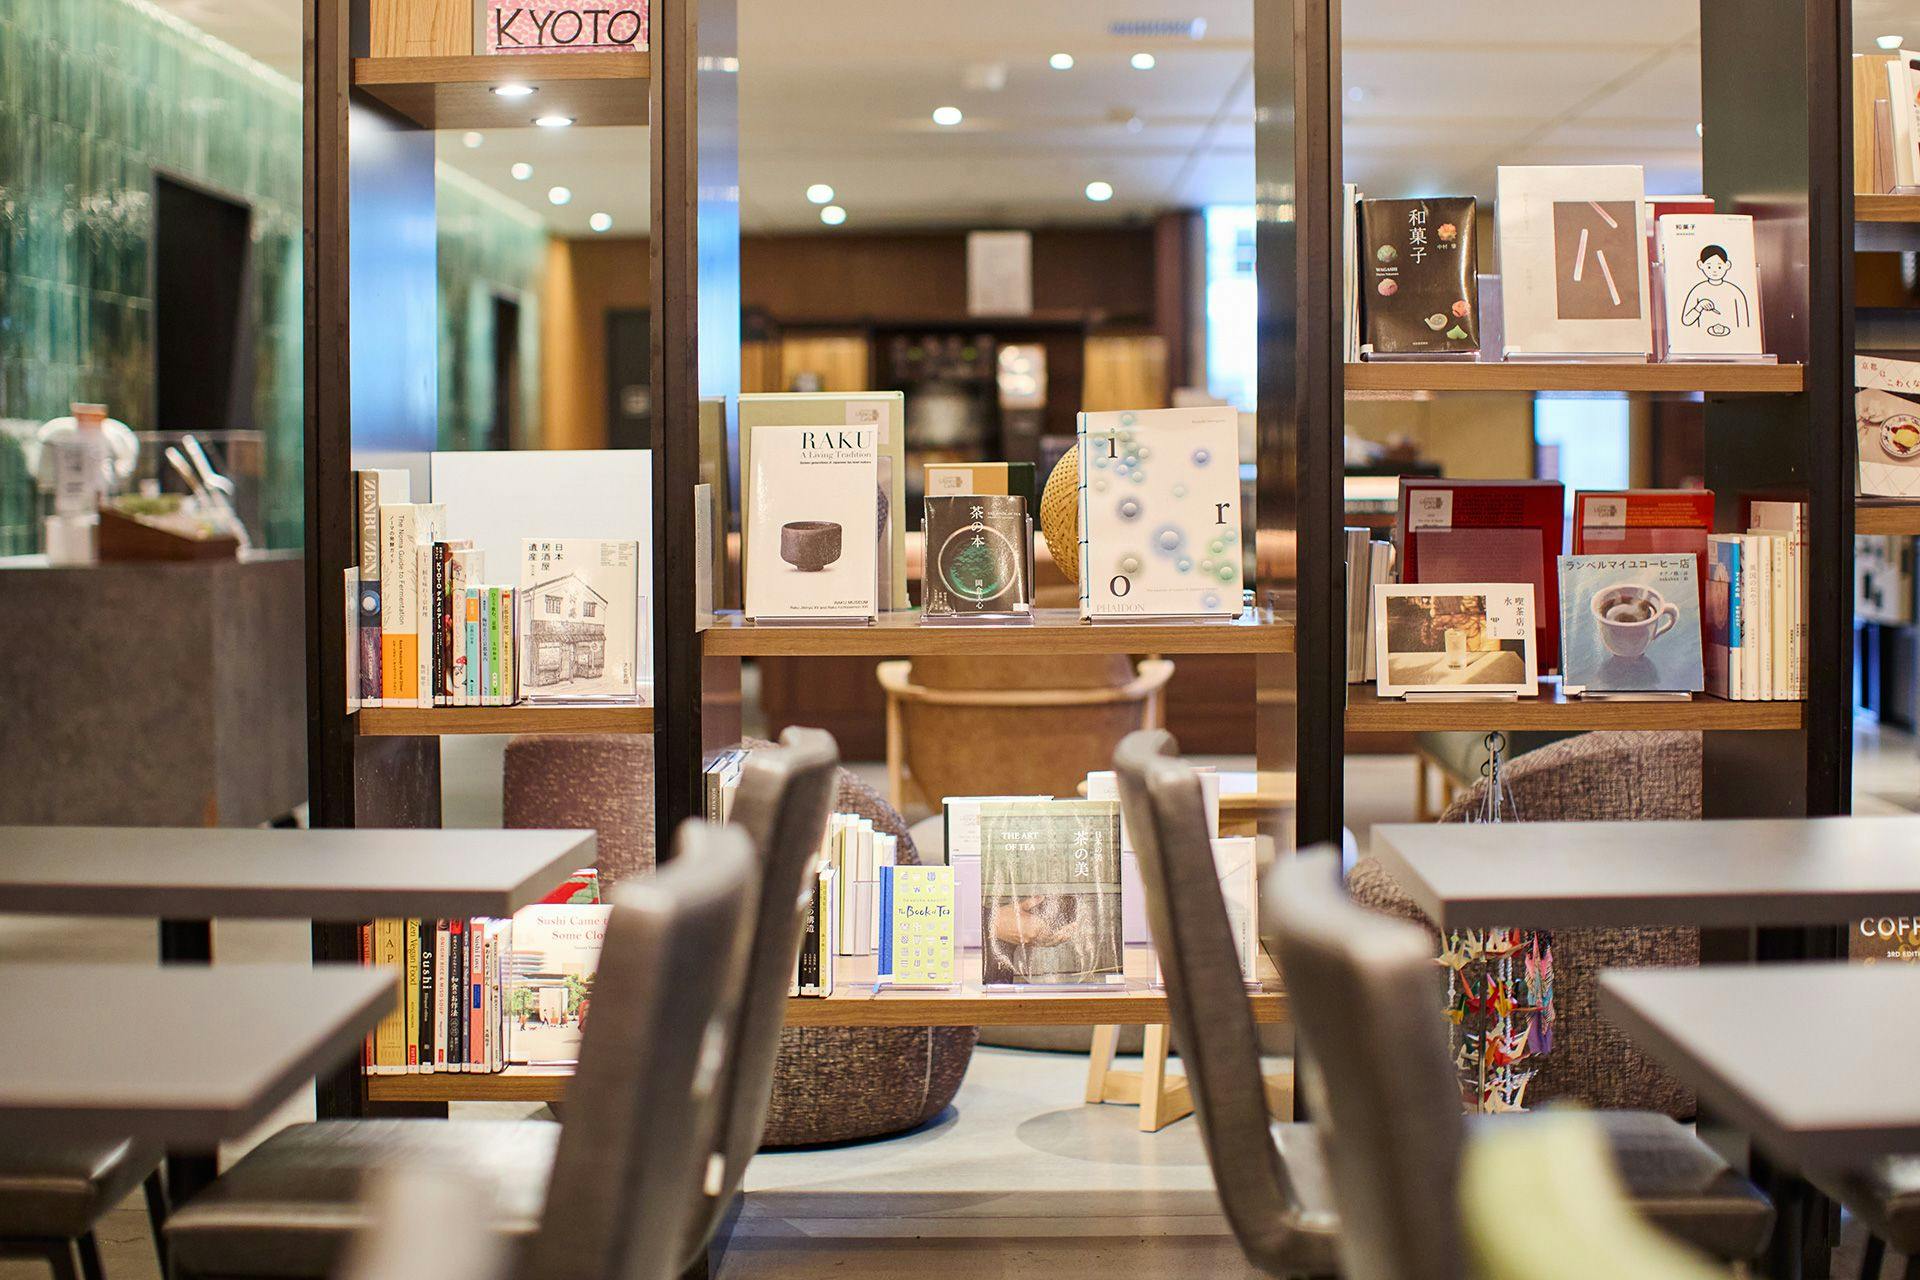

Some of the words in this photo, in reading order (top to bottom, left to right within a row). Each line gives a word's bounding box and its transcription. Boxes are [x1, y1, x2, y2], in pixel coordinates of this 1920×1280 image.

[496, 8, 641, 45] KYOTO
[1408, 209, 1428, 265] 和菓子
[800, 431, 872, 449] RAKU
[808, 451, 834, 460] Living
[836, 450, 872, 459] Tradition
[363, 479, 377, 537] ZENBU
[1215, 502, 1230, 525] r
[969, 505, 985, 547] 茶の本
[364, 540, 378, 575] ZEN
[528, 543, 537, 561] 遺産
[541, 543, 551, 571] 居酒屋
[555, 543, 564, 560] 日本
[398, 571, 405, 579] to
[1096, 603, 1144, 612] PHAIDON
[1504, 596, 1512, 606] 水
[1514, 597, 1525, 636] 喫茶店の
[1001, 832, 1021, 840] THE
[1021, 832, 1039, 840] ART
[1005, 843, 1017, 851] OF
[1019, 843, 1036, 851] TEA
[1073, 830, 1089, 876] 茶の美
[537, 915, 566, 925] Sushi
[570, 915, 600, 925] Came
[906, 905, 931, 919] Book
[410, 921, 418, 937] Zen
[551, 931, 582, 940] Some
[408, 939, 418, 963] Vegan
[409, 965, 418, 986] Food
[422, 951, 432, 990] Sushi
